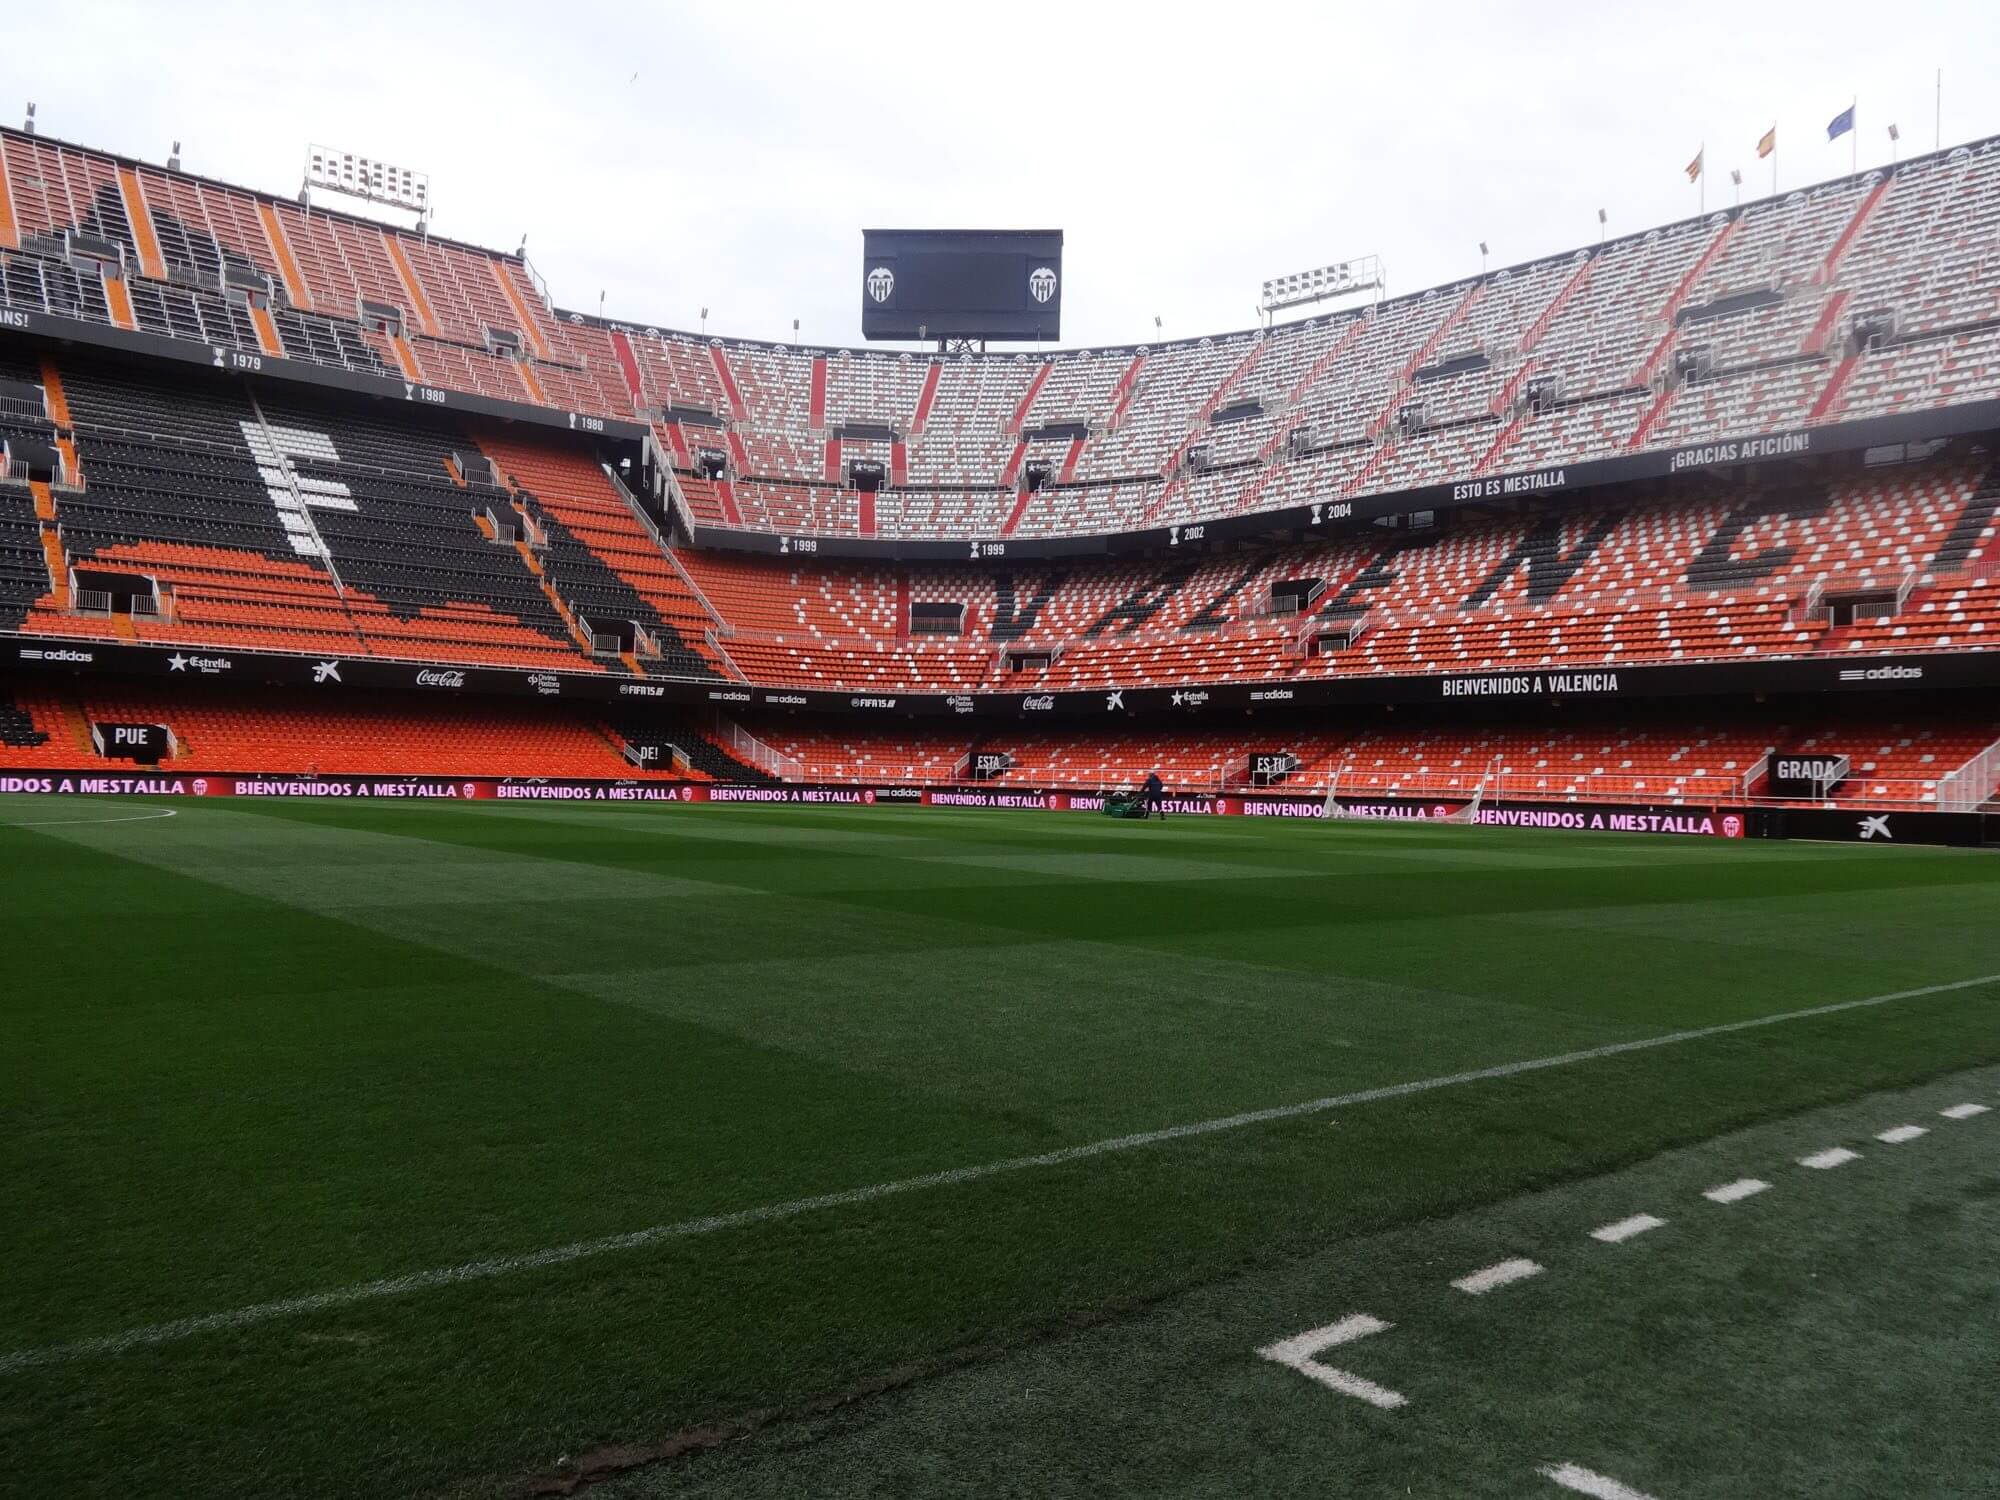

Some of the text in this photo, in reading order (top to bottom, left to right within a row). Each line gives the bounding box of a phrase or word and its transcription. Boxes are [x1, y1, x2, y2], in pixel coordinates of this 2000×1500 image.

[232, 352, 261, 371] 1979
[420, 387, 446, 403] 1980
[581, 417, 604, 432] 1980
[1670, 432, 1810, 472] ¡GRACIAS AFICIÓN!
[1453, 470, 1566, 501] ESTO ES MESTALLA
[1328, 503, 1351, 519] 2004
[1184, 525, 1205, 541] 2002
[793, 539, 817, 552] 1999
[982, 543, 1005, 556] 1999
[44, 650, 93, 662] adidas
[190, 656, 232, 669] Estrella
[1866, 665, 1923, 680] adidas
[1442, 673, 1618, 697] BIENVENIDOS A VALENCIA
[722, 691, 750, 701] adidas
[779, 694, 807, 705] adidas
[1263, 689, 1294, 700] adidas
[115, 727, 149, 745] PUE
[640, 746, 659, 760] DE!
[977, 755, 1000, 769] ESTA
[1257, 756, 1270, 771] ES
[1777, 760, 1837, 780] GRADA
[58, 779, 75, 793] A
[80, 779, 186, 795] MESTALLA
[235, 782, 457, 797] BIENVENIDOS A MESTALLA
[497, 786, 677, 800] BIENVENIDOS A MESTALLA
[890, 788, 922, 797] adidas
[710, 789, 860, 803] BIENVENIDOS A MESTALLA
[931, 793, 1045, 808] BIENVENIDOS A MESTALLA
[1244, 802, 1328, 818] BIENVENIDOS
[1350, 805, 1426, 818] MESTALLA
[1473, 809, 1714, 834] BIENVENIDOS A MESTALLA
